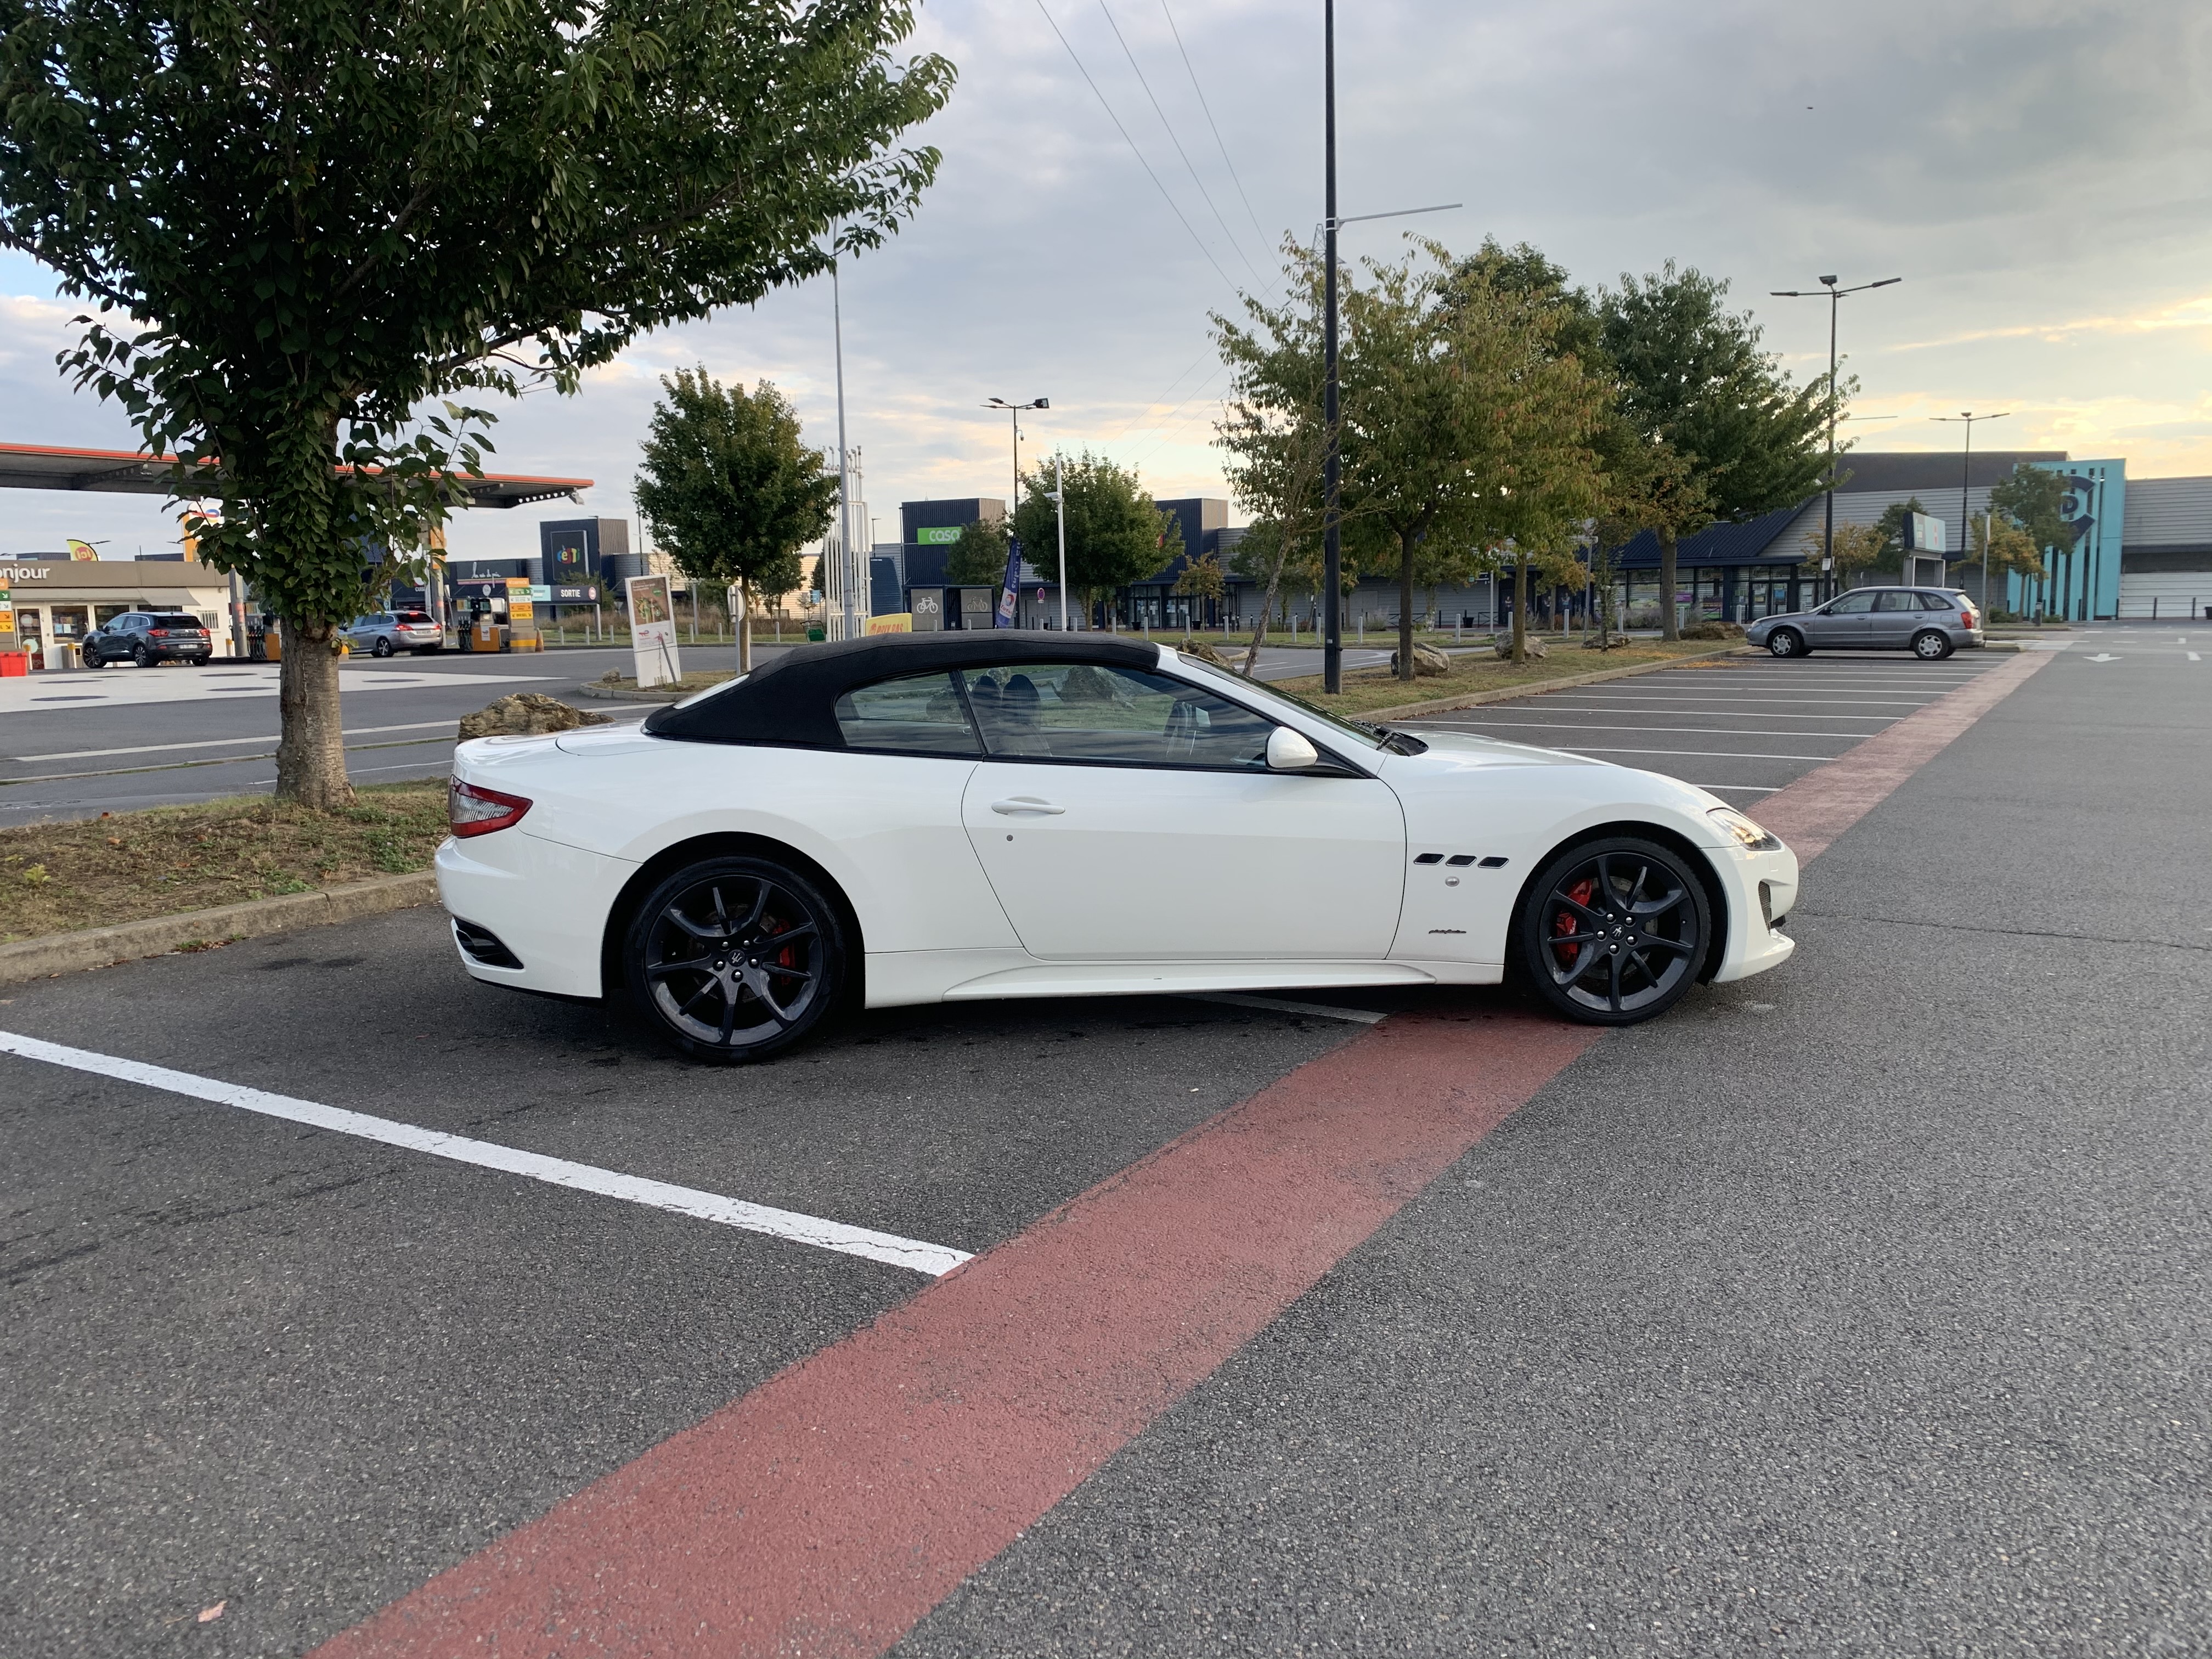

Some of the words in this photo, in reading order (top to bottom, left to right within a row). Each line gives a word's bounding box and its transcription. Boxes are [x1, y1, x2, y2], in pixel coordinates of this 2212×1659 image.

[929, 529, 960, 542] casa
[0, 563, 50, 583] njour
[561, 589, 581, 597] SORTIE
